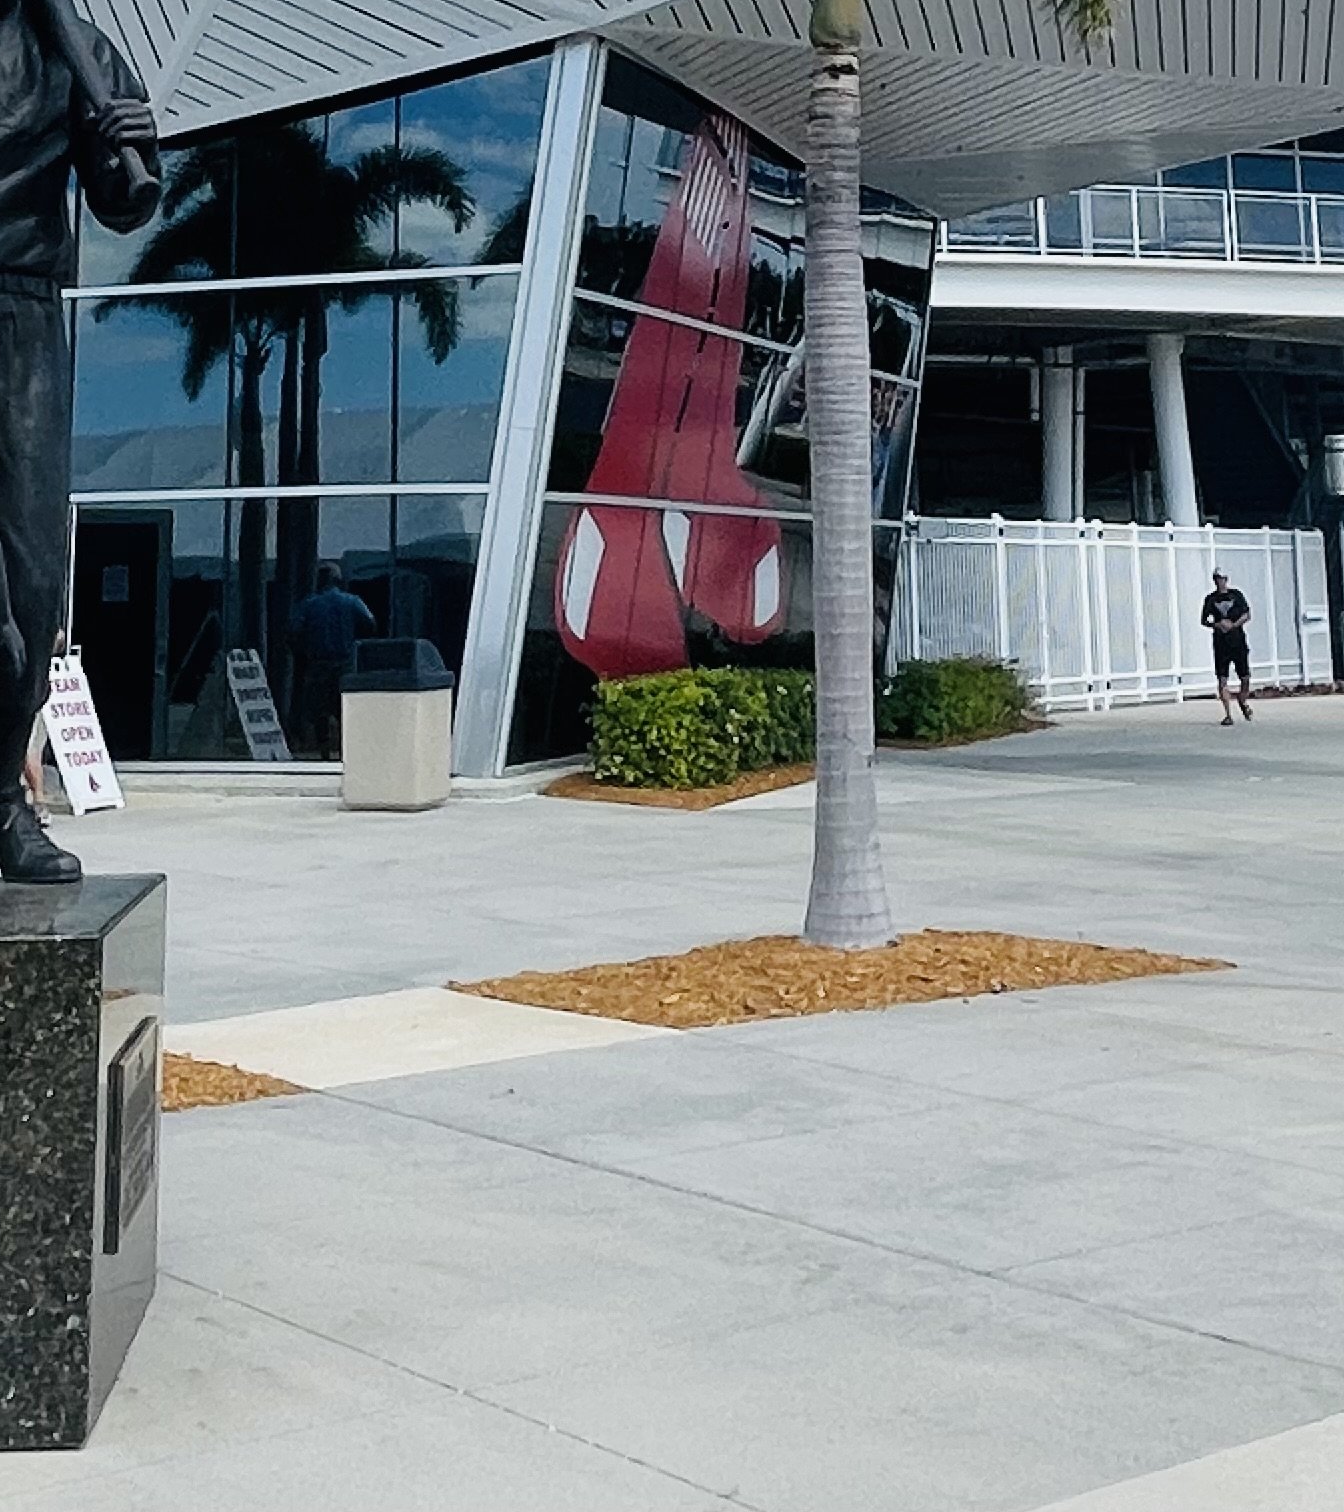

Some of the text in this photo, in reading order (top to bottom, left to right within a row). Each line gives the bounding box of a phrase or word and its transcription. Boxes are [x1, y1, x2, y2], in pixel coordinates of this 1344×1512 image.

[50, 701, 92, 719] STORE
[61, 726, 94, 742] OPEN
[64, 749, 104, 768] TODAY
